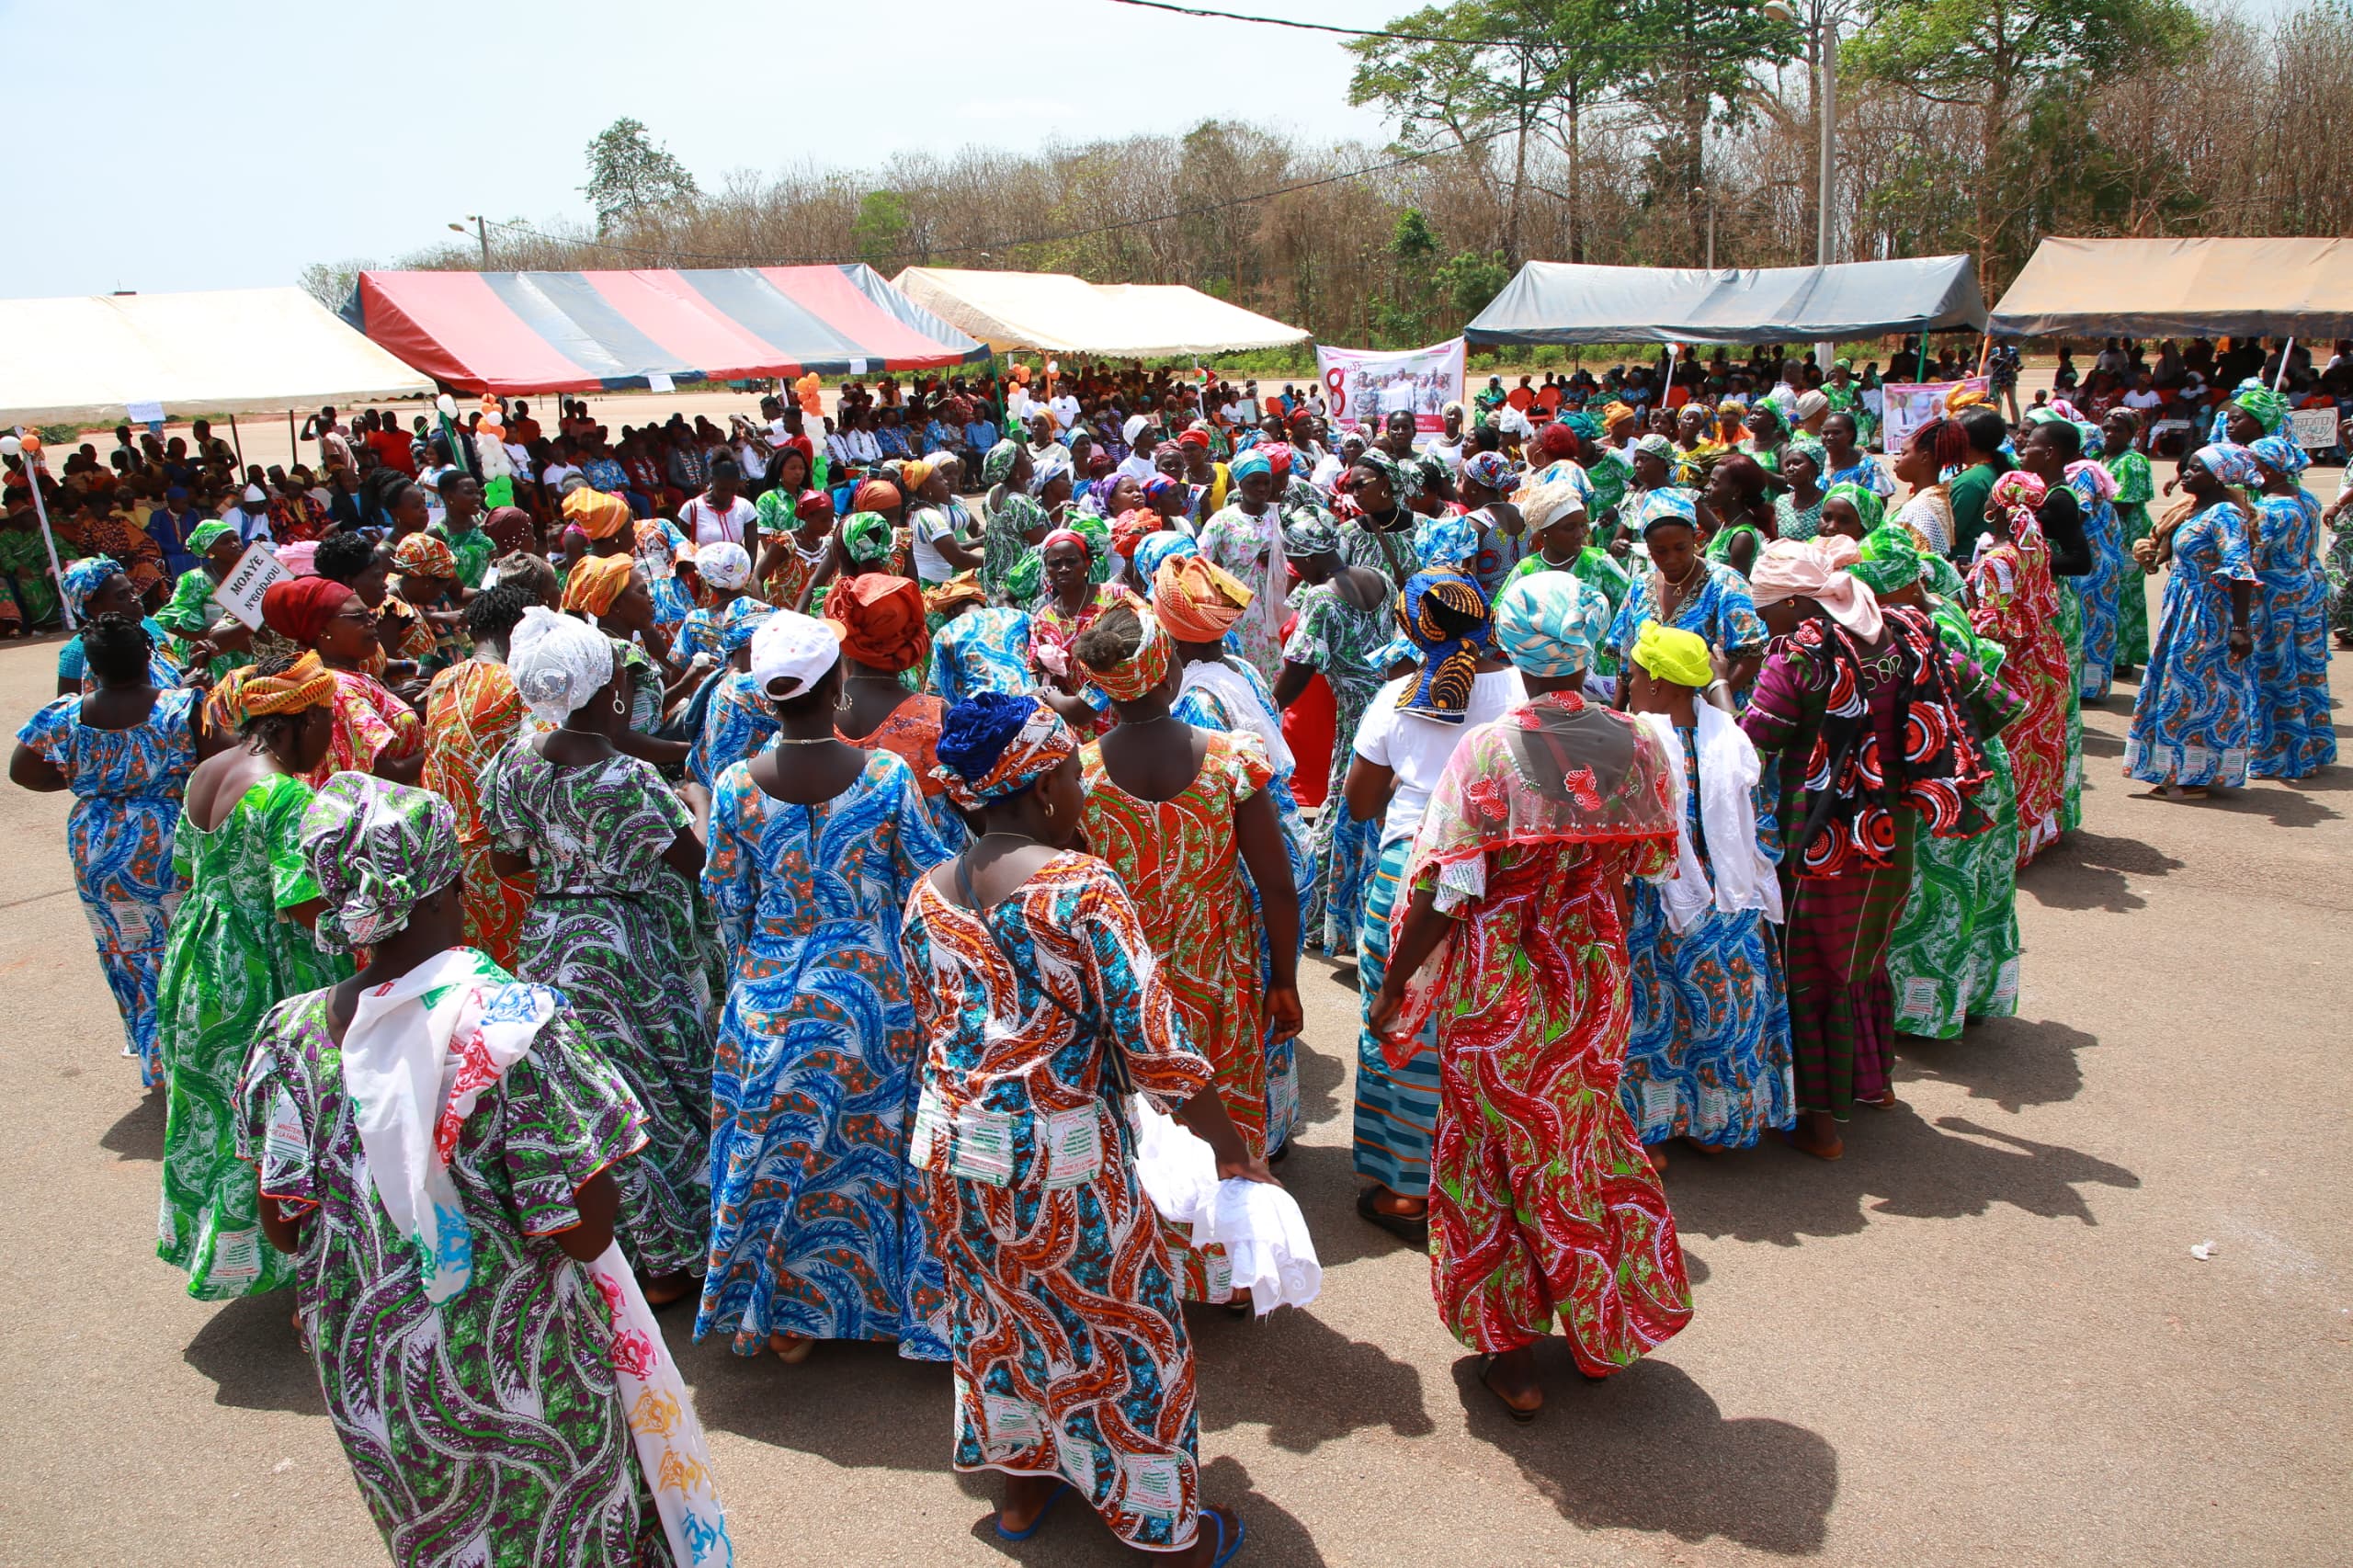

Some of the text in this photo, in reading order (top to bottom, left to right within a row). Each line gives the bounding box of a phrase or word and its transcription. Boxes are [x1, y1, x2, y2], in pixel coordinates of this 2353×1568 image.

[1326, 367, 1346, 417] 8
[230, 554, 265, 596] MOAYE
[244, 564, 280, 611] N'GODJOU
